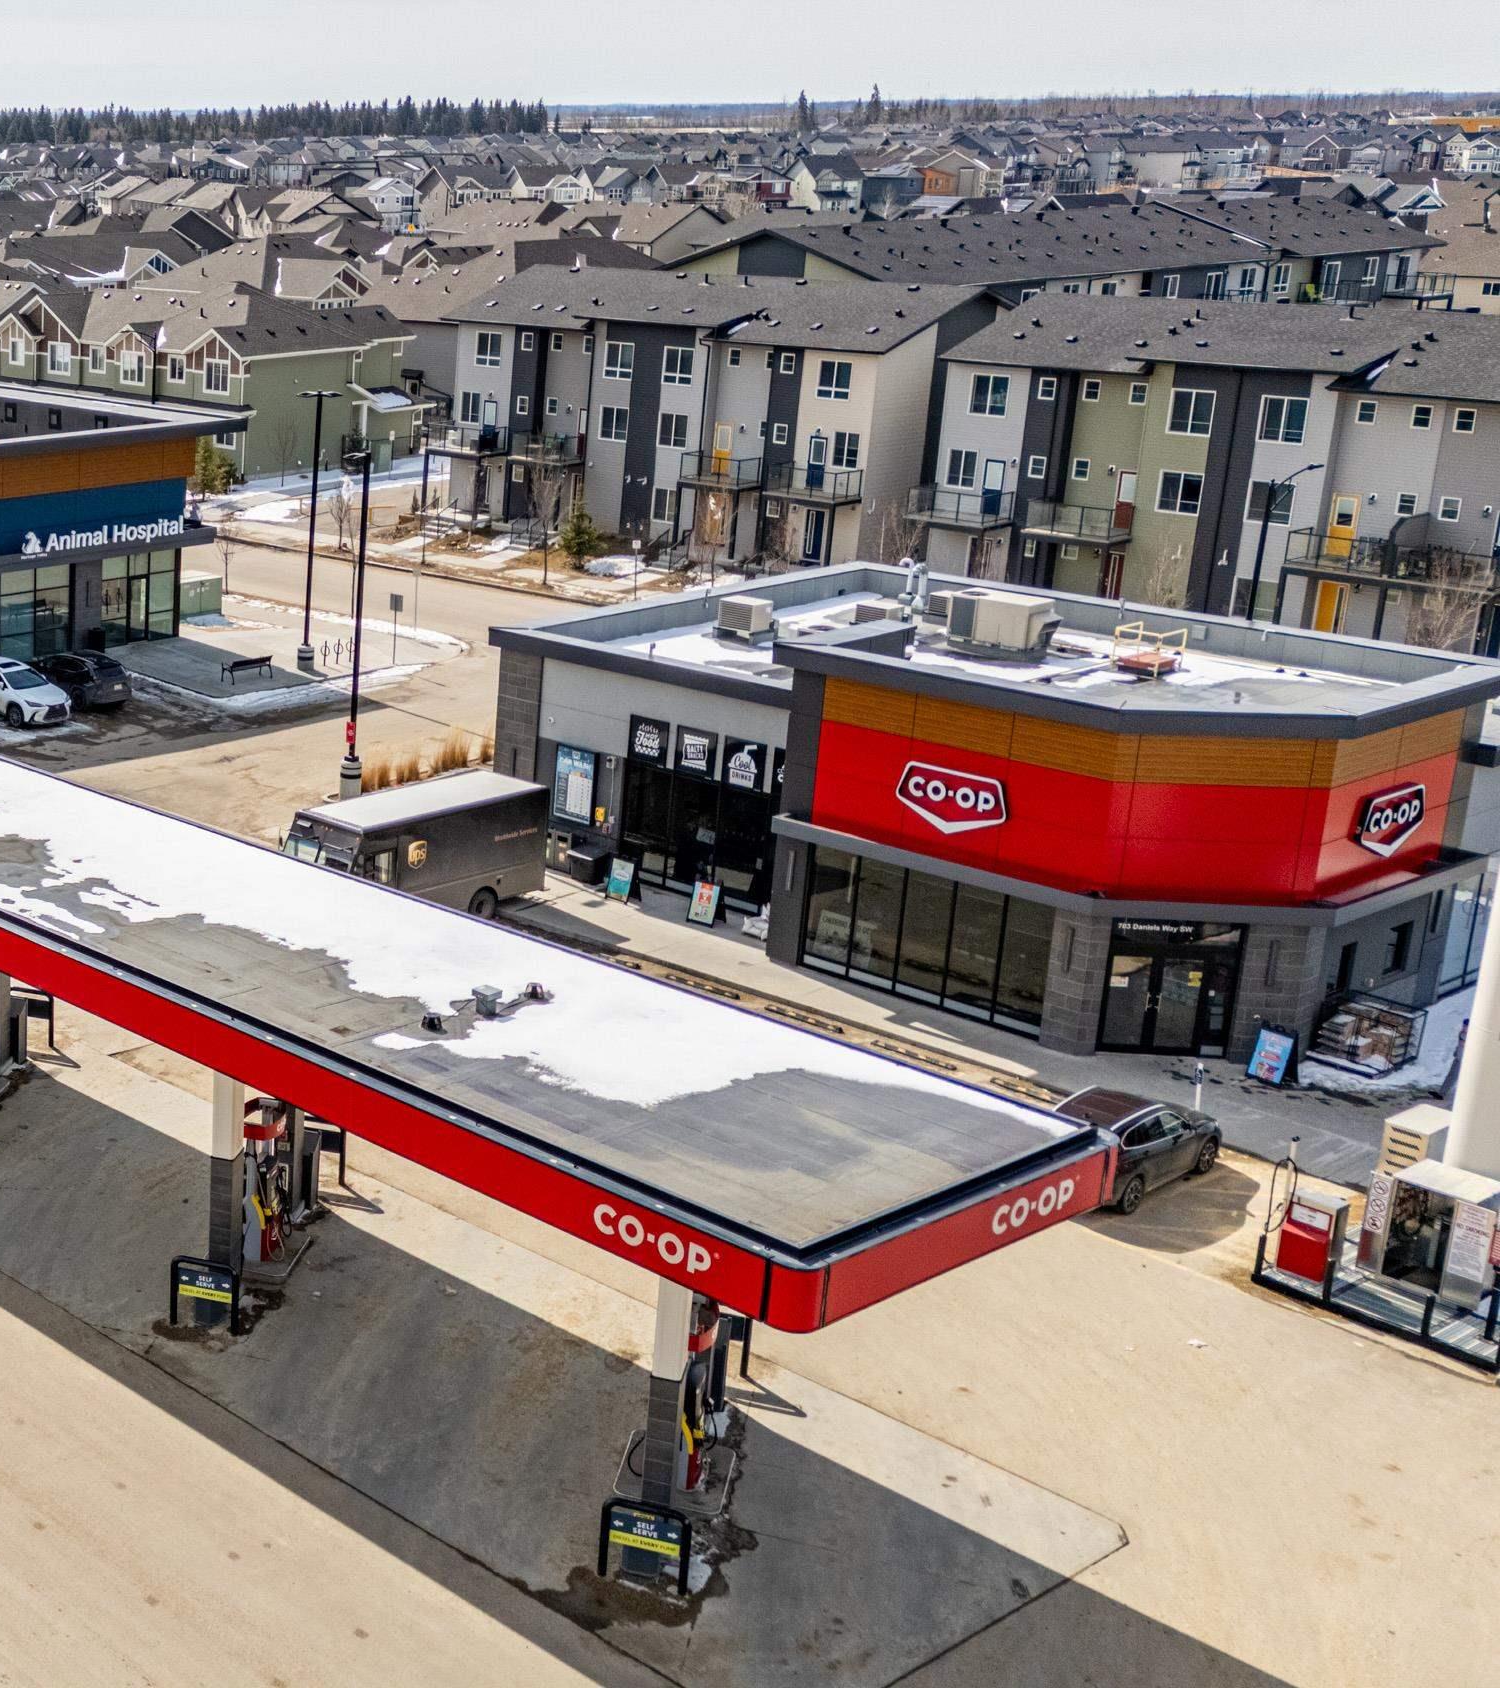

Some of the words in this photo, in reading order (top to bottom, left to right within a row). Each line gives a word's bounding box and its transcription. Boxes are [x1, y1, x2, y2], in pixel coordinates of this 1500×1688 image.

[45, 525, 107, 552] Animal
[113, 515, 185, 544] Hospital
[636, 731, 660, 749] Food
[1162, 925, 1178, 933] Way
[196, 1280, 215, 1289] SERVE
[637, 1521, 656, 1530] SELF
[633, 1527, 658, 1538] SERVE
[640, 1540, 659, 1549] EVERY
